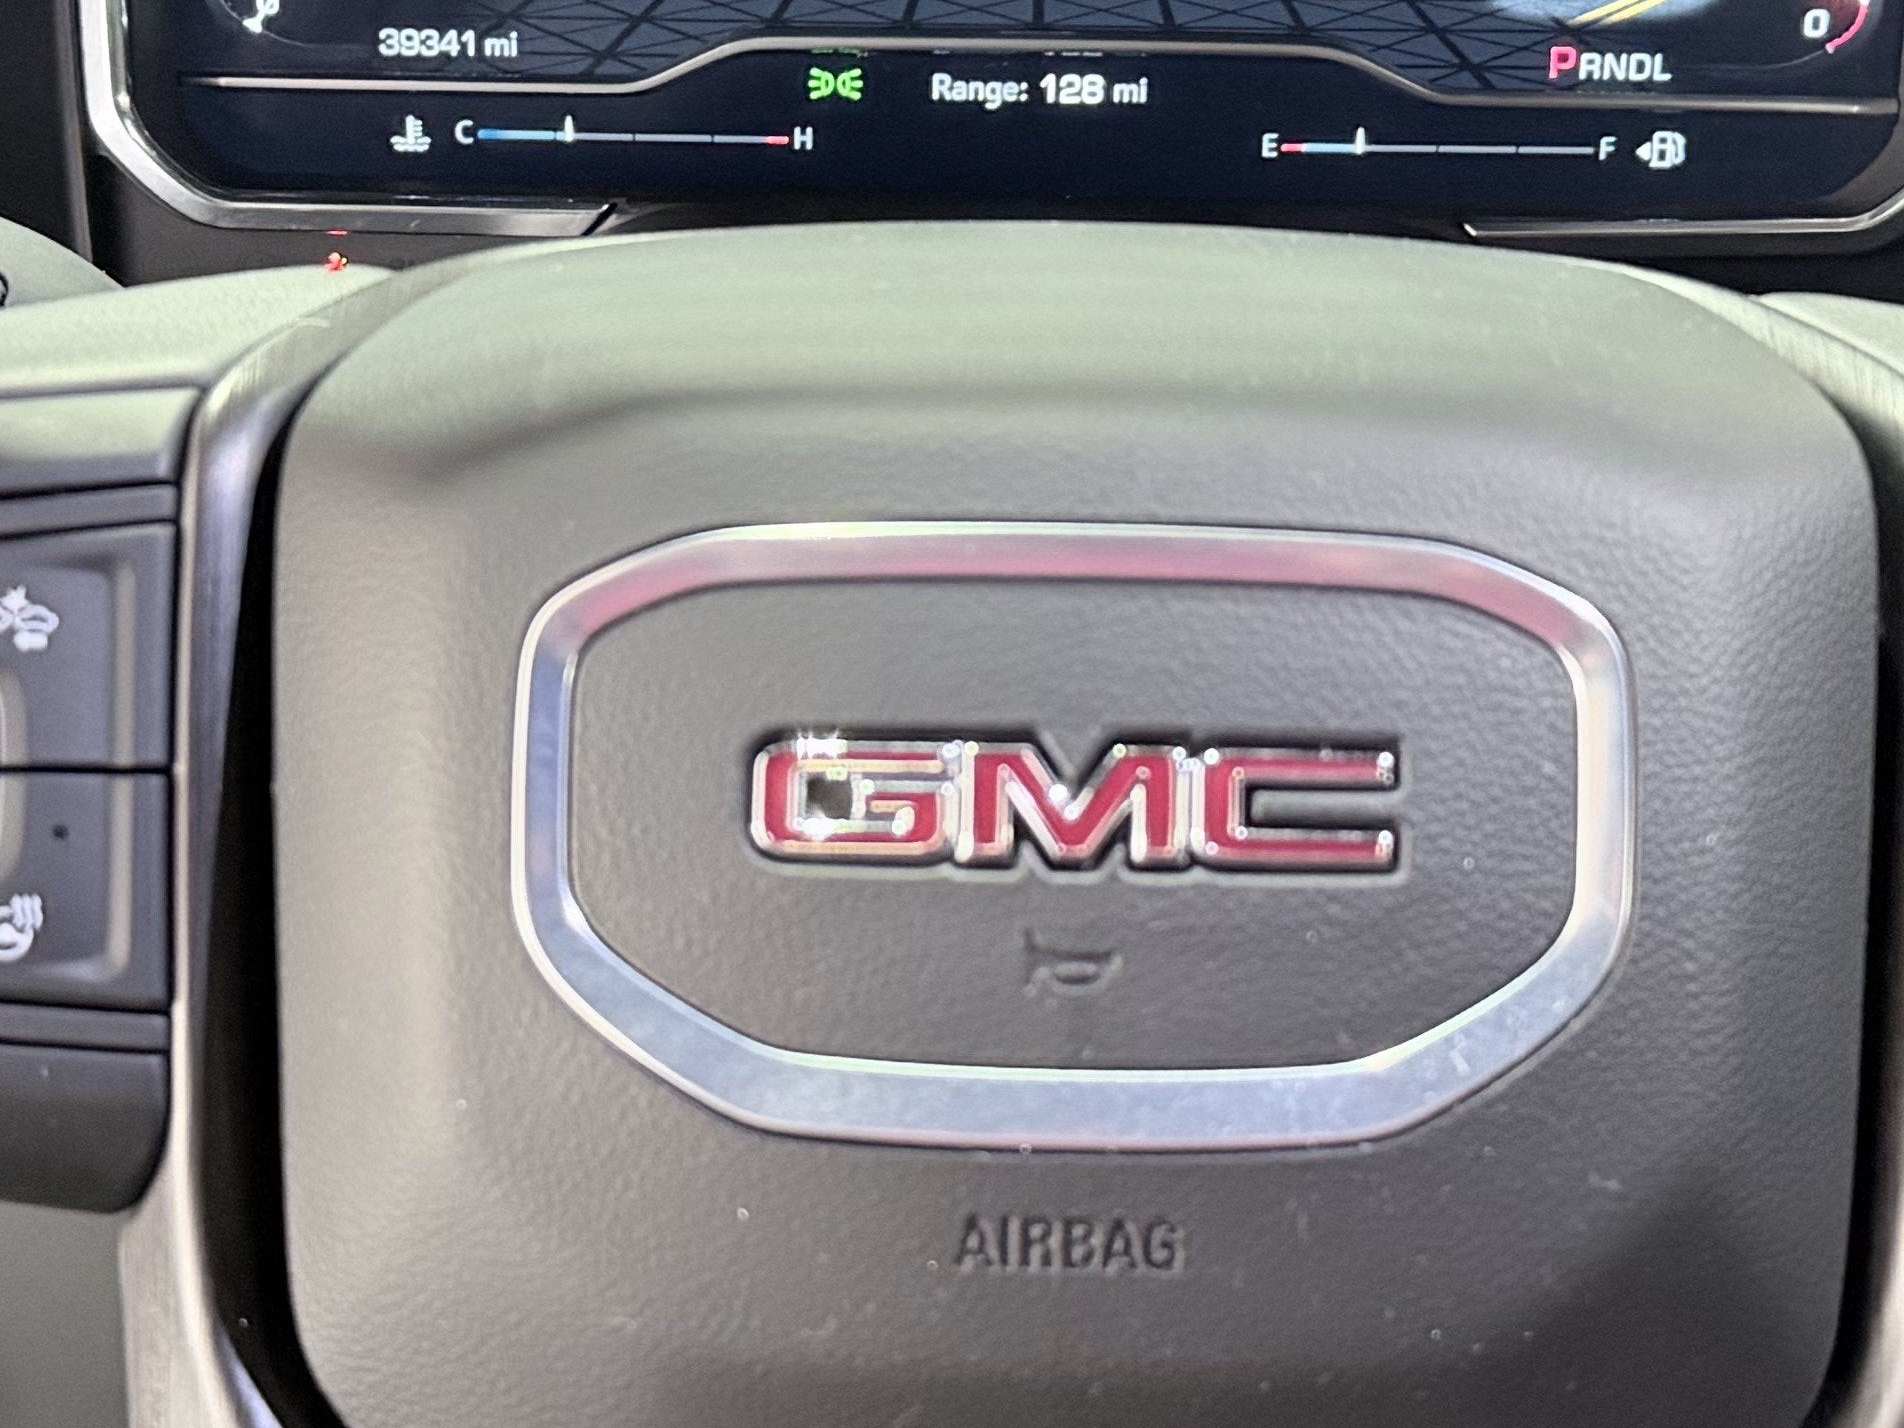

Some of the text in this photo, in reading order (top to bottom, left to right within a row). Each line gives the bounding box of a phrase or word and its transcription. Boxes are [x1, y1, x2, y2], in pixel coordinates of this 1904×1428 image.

[1803, 8, 1830, 39] 0
[378, 26, 518, 58] 39341 mi
[1548, 45, 1672, 82] PRNDL
[931, 72, 1148, 110] Range: 128 mi
[454, 118, 474, 145] C
[793, 125, 813, 150] H
[1261, 132, 1279, 158] E
[1598, 135, 1618, 161] F
[747, 740, 1400, 870] GMC
[955, 1214, 1185, 1272] AIRBAG
